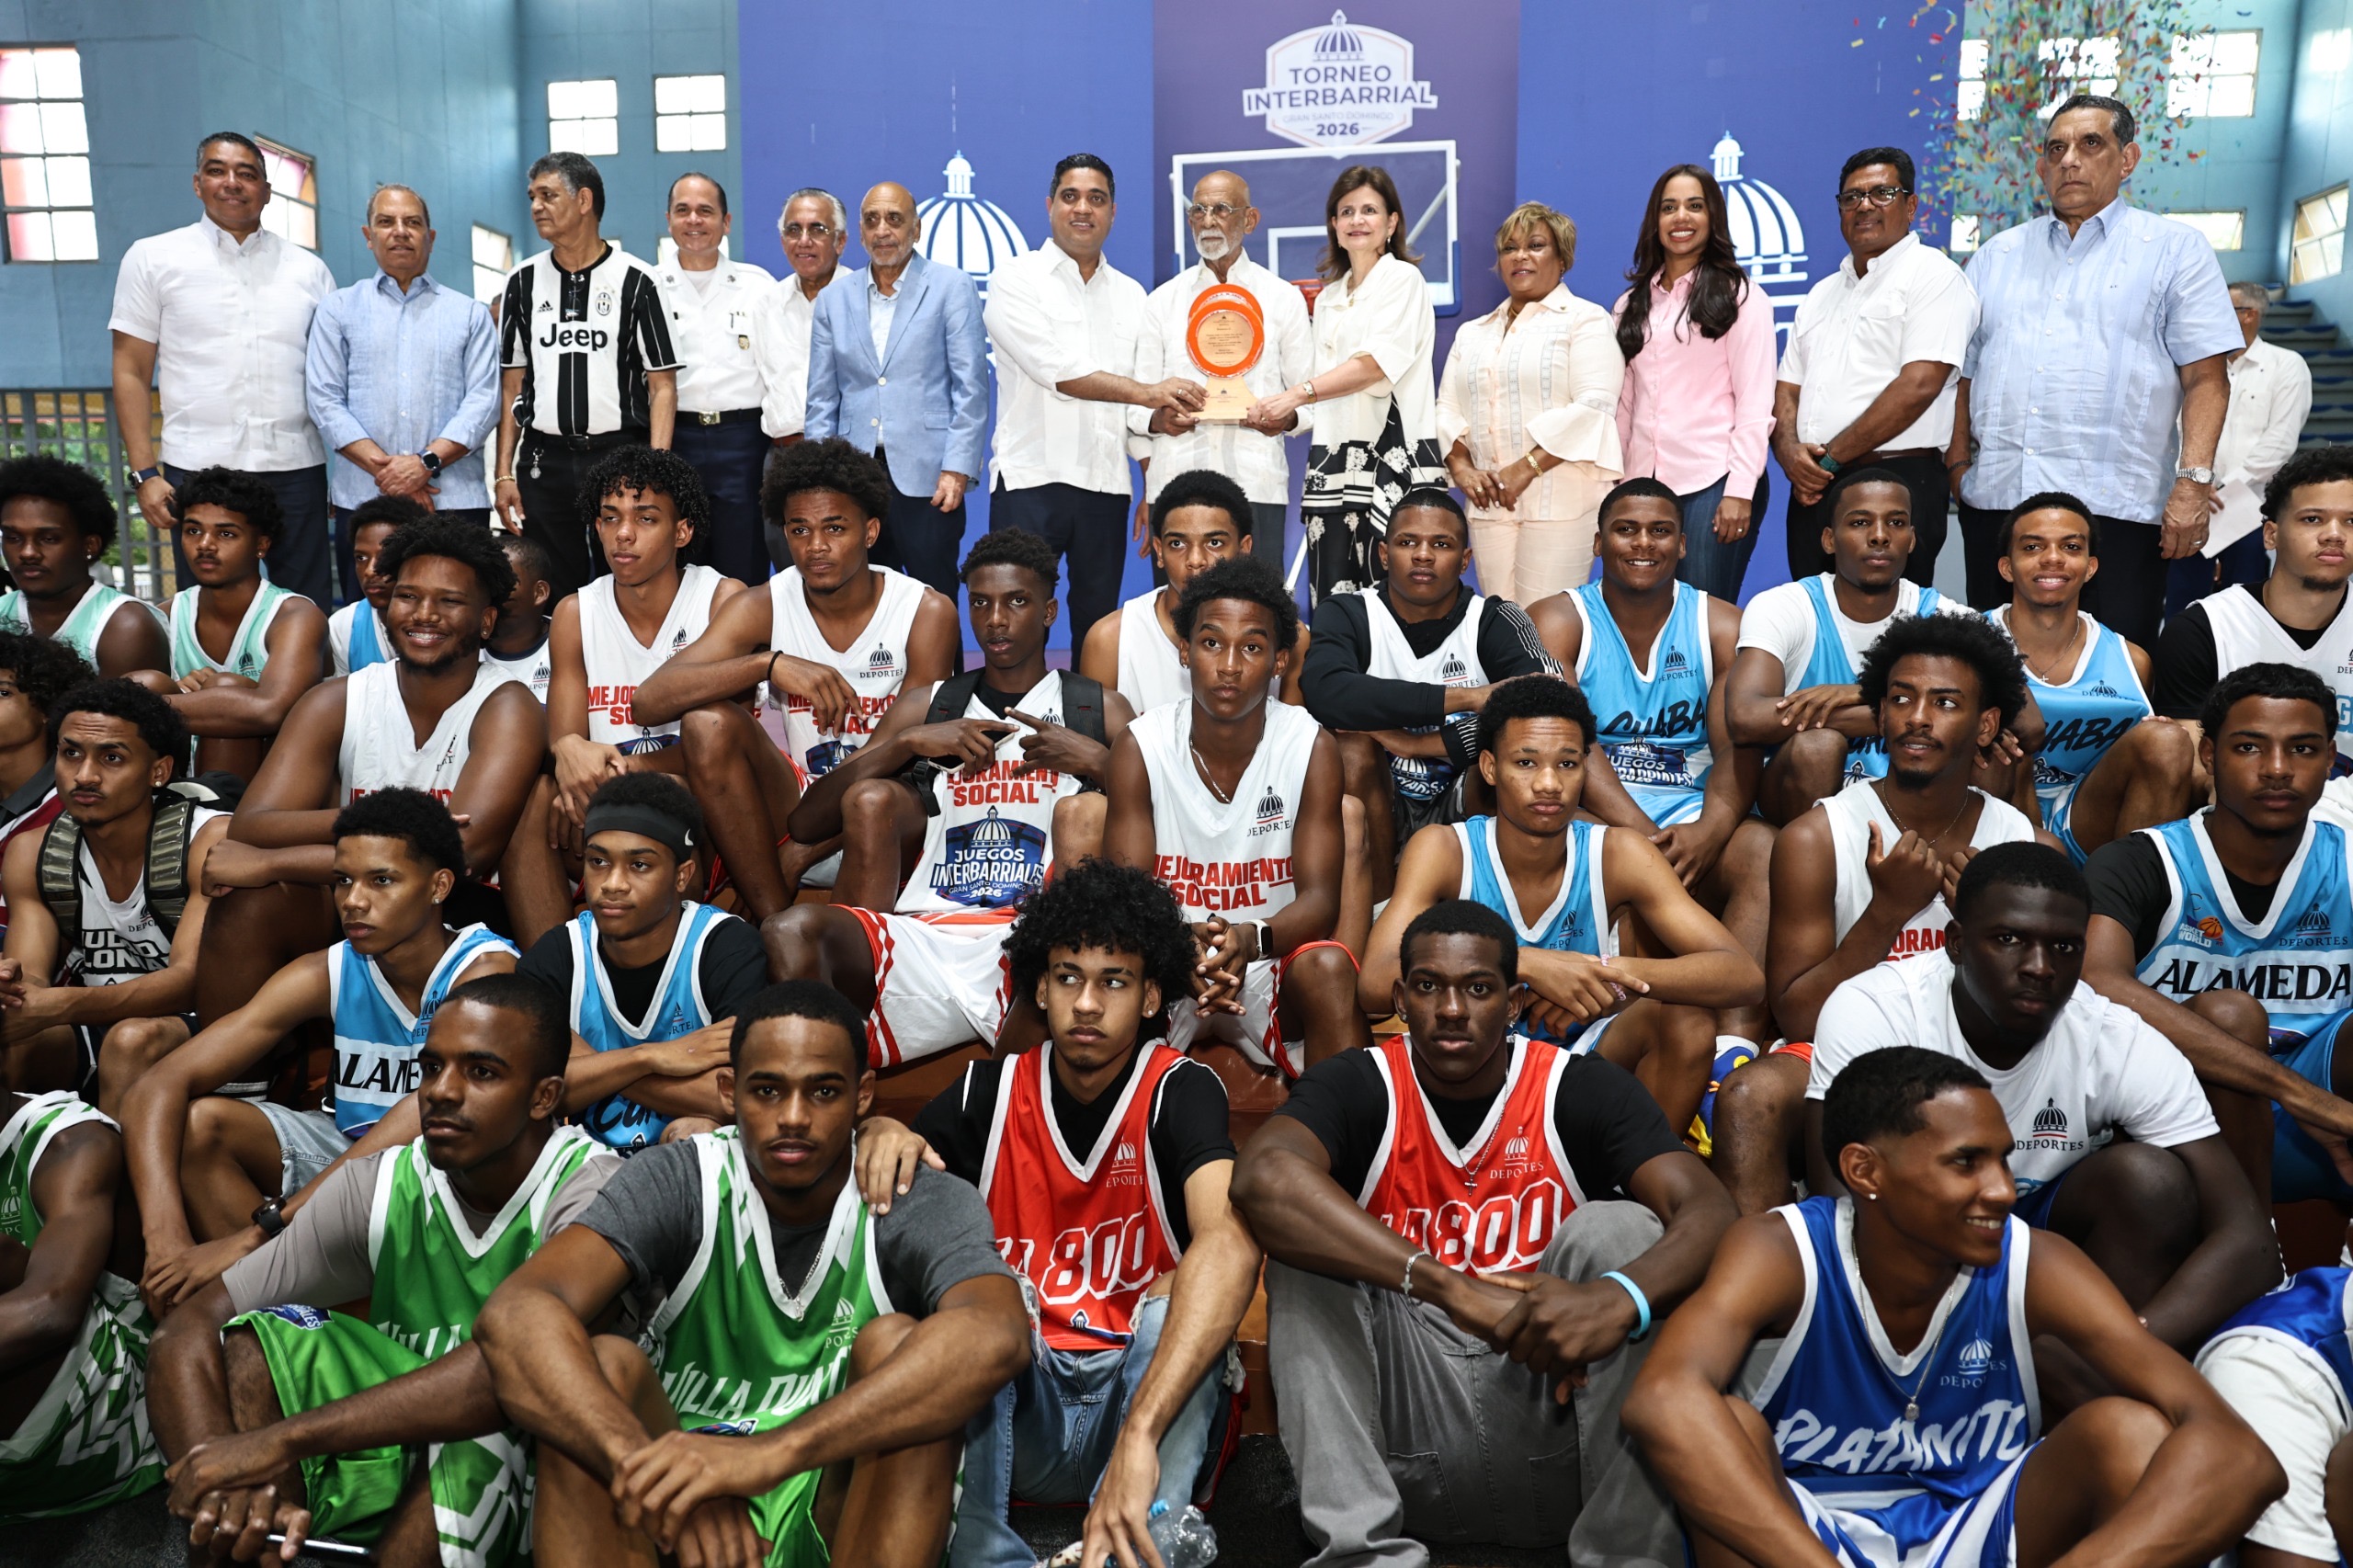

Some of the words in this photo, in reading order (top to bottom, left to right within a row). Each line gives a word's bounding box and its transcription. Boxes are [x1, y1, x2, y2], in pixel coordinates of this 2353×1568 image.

[1290, 65, 1392, 85] TORNEO
[1246, 85, 1433, 111] INTERBARRIAL
[1283, 113, 1310, 123] GRAN
[1312, 111, 1345, 122] SANTO
[1346, 110, 1394, 121] DOMINGO
[1316, 123, 1360, 136] 2026
[540, 323, 608, 352] Jeep
[859, 668, 904, 678] DEPORTES
[953, 781, 1040, 807] SOCIAL
[954, 847, 1025, 863] JUEGOS
[948, 884, 969, 894] GRAN
[969, 880, 991, 891] SANTO
[969, 886, 1003, 899] 2026
[1170, 881, 1267, 911] SOCIAL
[2178, 930, 2213, 949] WORLD
[2279, 936, 2349, 948] DEPORTES
[2149, 958, 2351, 1000] ALAMEDA
[2016, 1139, 2085, 1152] DEPORTES
[1489, 1162, 1545, 1180] DEPOTES
[1435, 1176, 1563, 1274] 800
